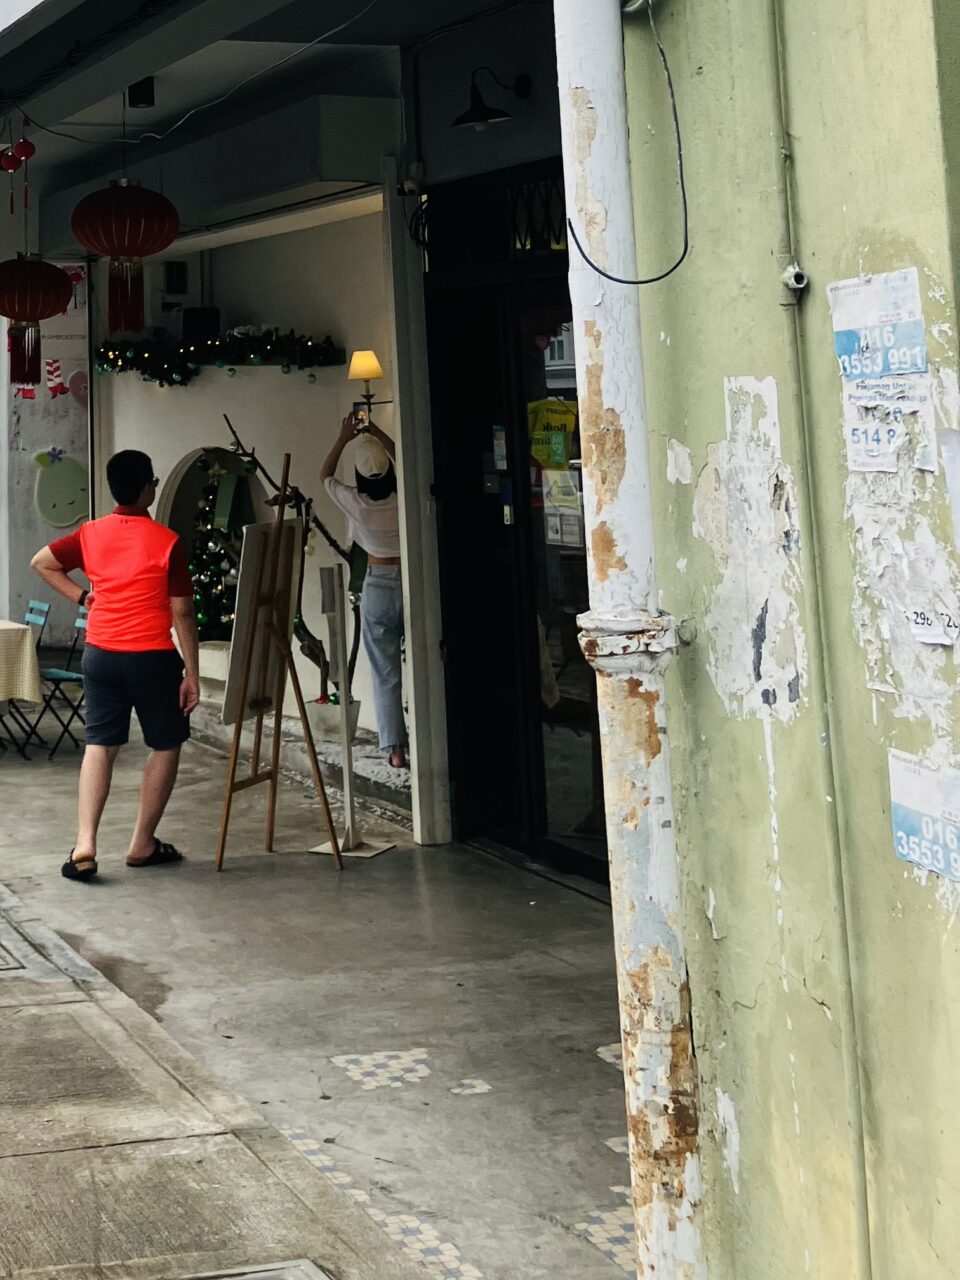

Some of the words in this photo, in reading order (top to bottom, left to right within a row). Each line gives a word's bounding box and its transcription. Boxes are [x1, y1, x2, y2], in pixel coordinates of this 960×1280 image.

[887, 345, 924, 370] 991
[851, 427, 881, 446] 514
[920, 816, 958, 850] 016
[896, 830, 945, 870] 3553
